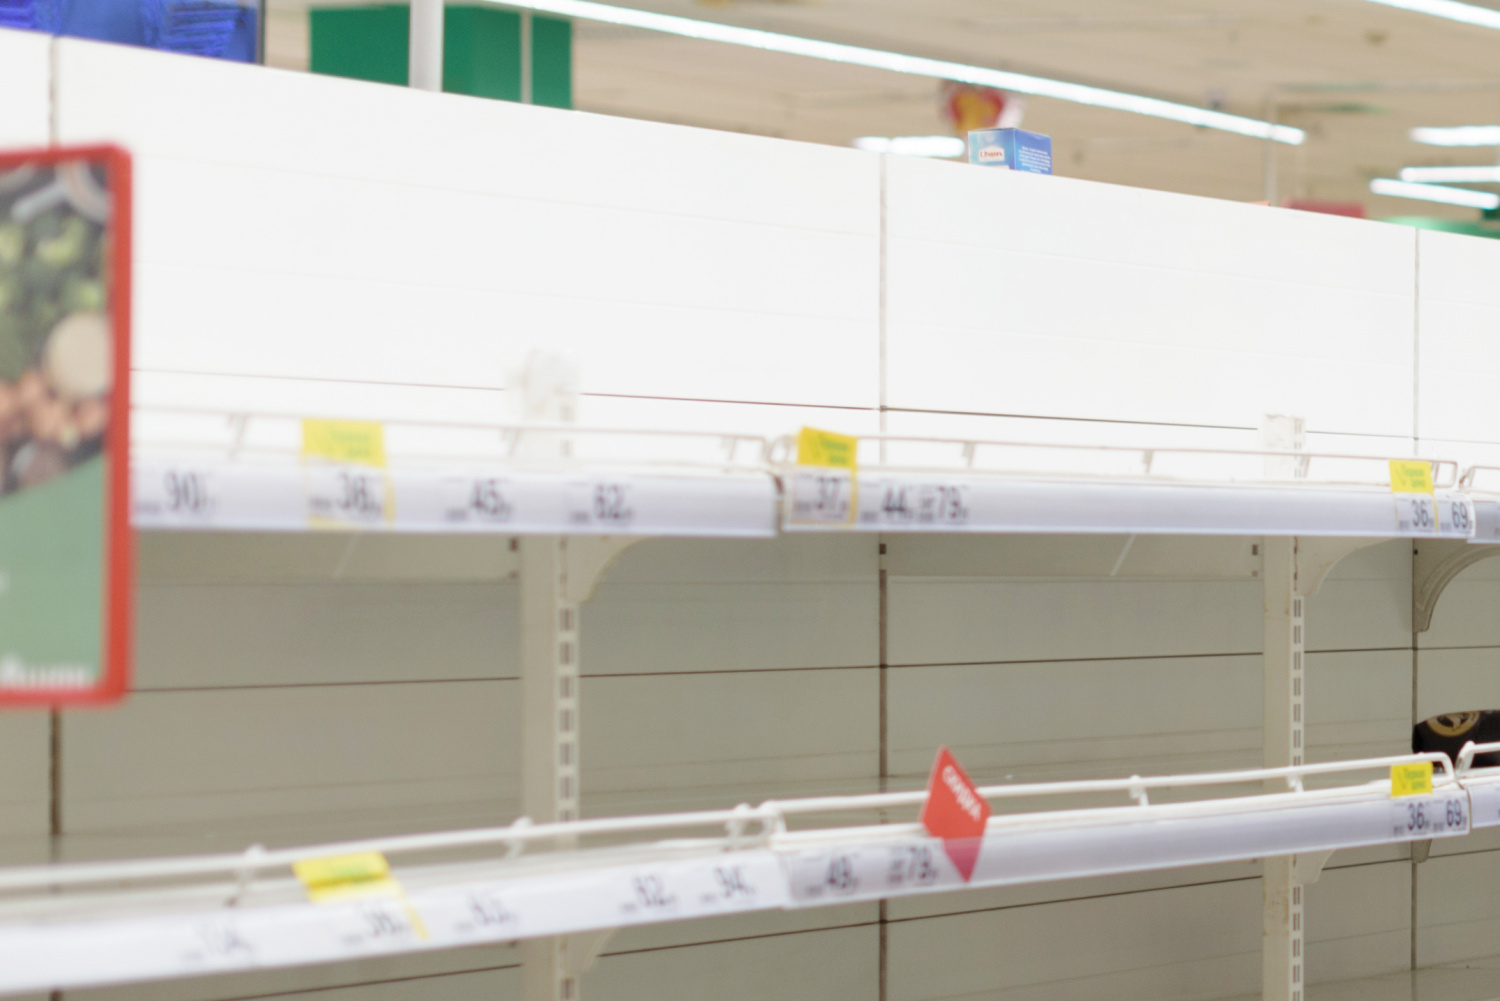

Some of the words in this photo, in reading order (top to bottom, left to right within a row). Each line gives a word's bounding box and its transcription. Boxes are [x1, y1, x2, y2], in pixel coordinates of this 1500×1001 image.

[1412, 499, 1429, 528] 36
[1451, 501, 1469, 529] 69
[1407, 802, 1425, 831] 36
[1446, 800, 1462, 827] 69
